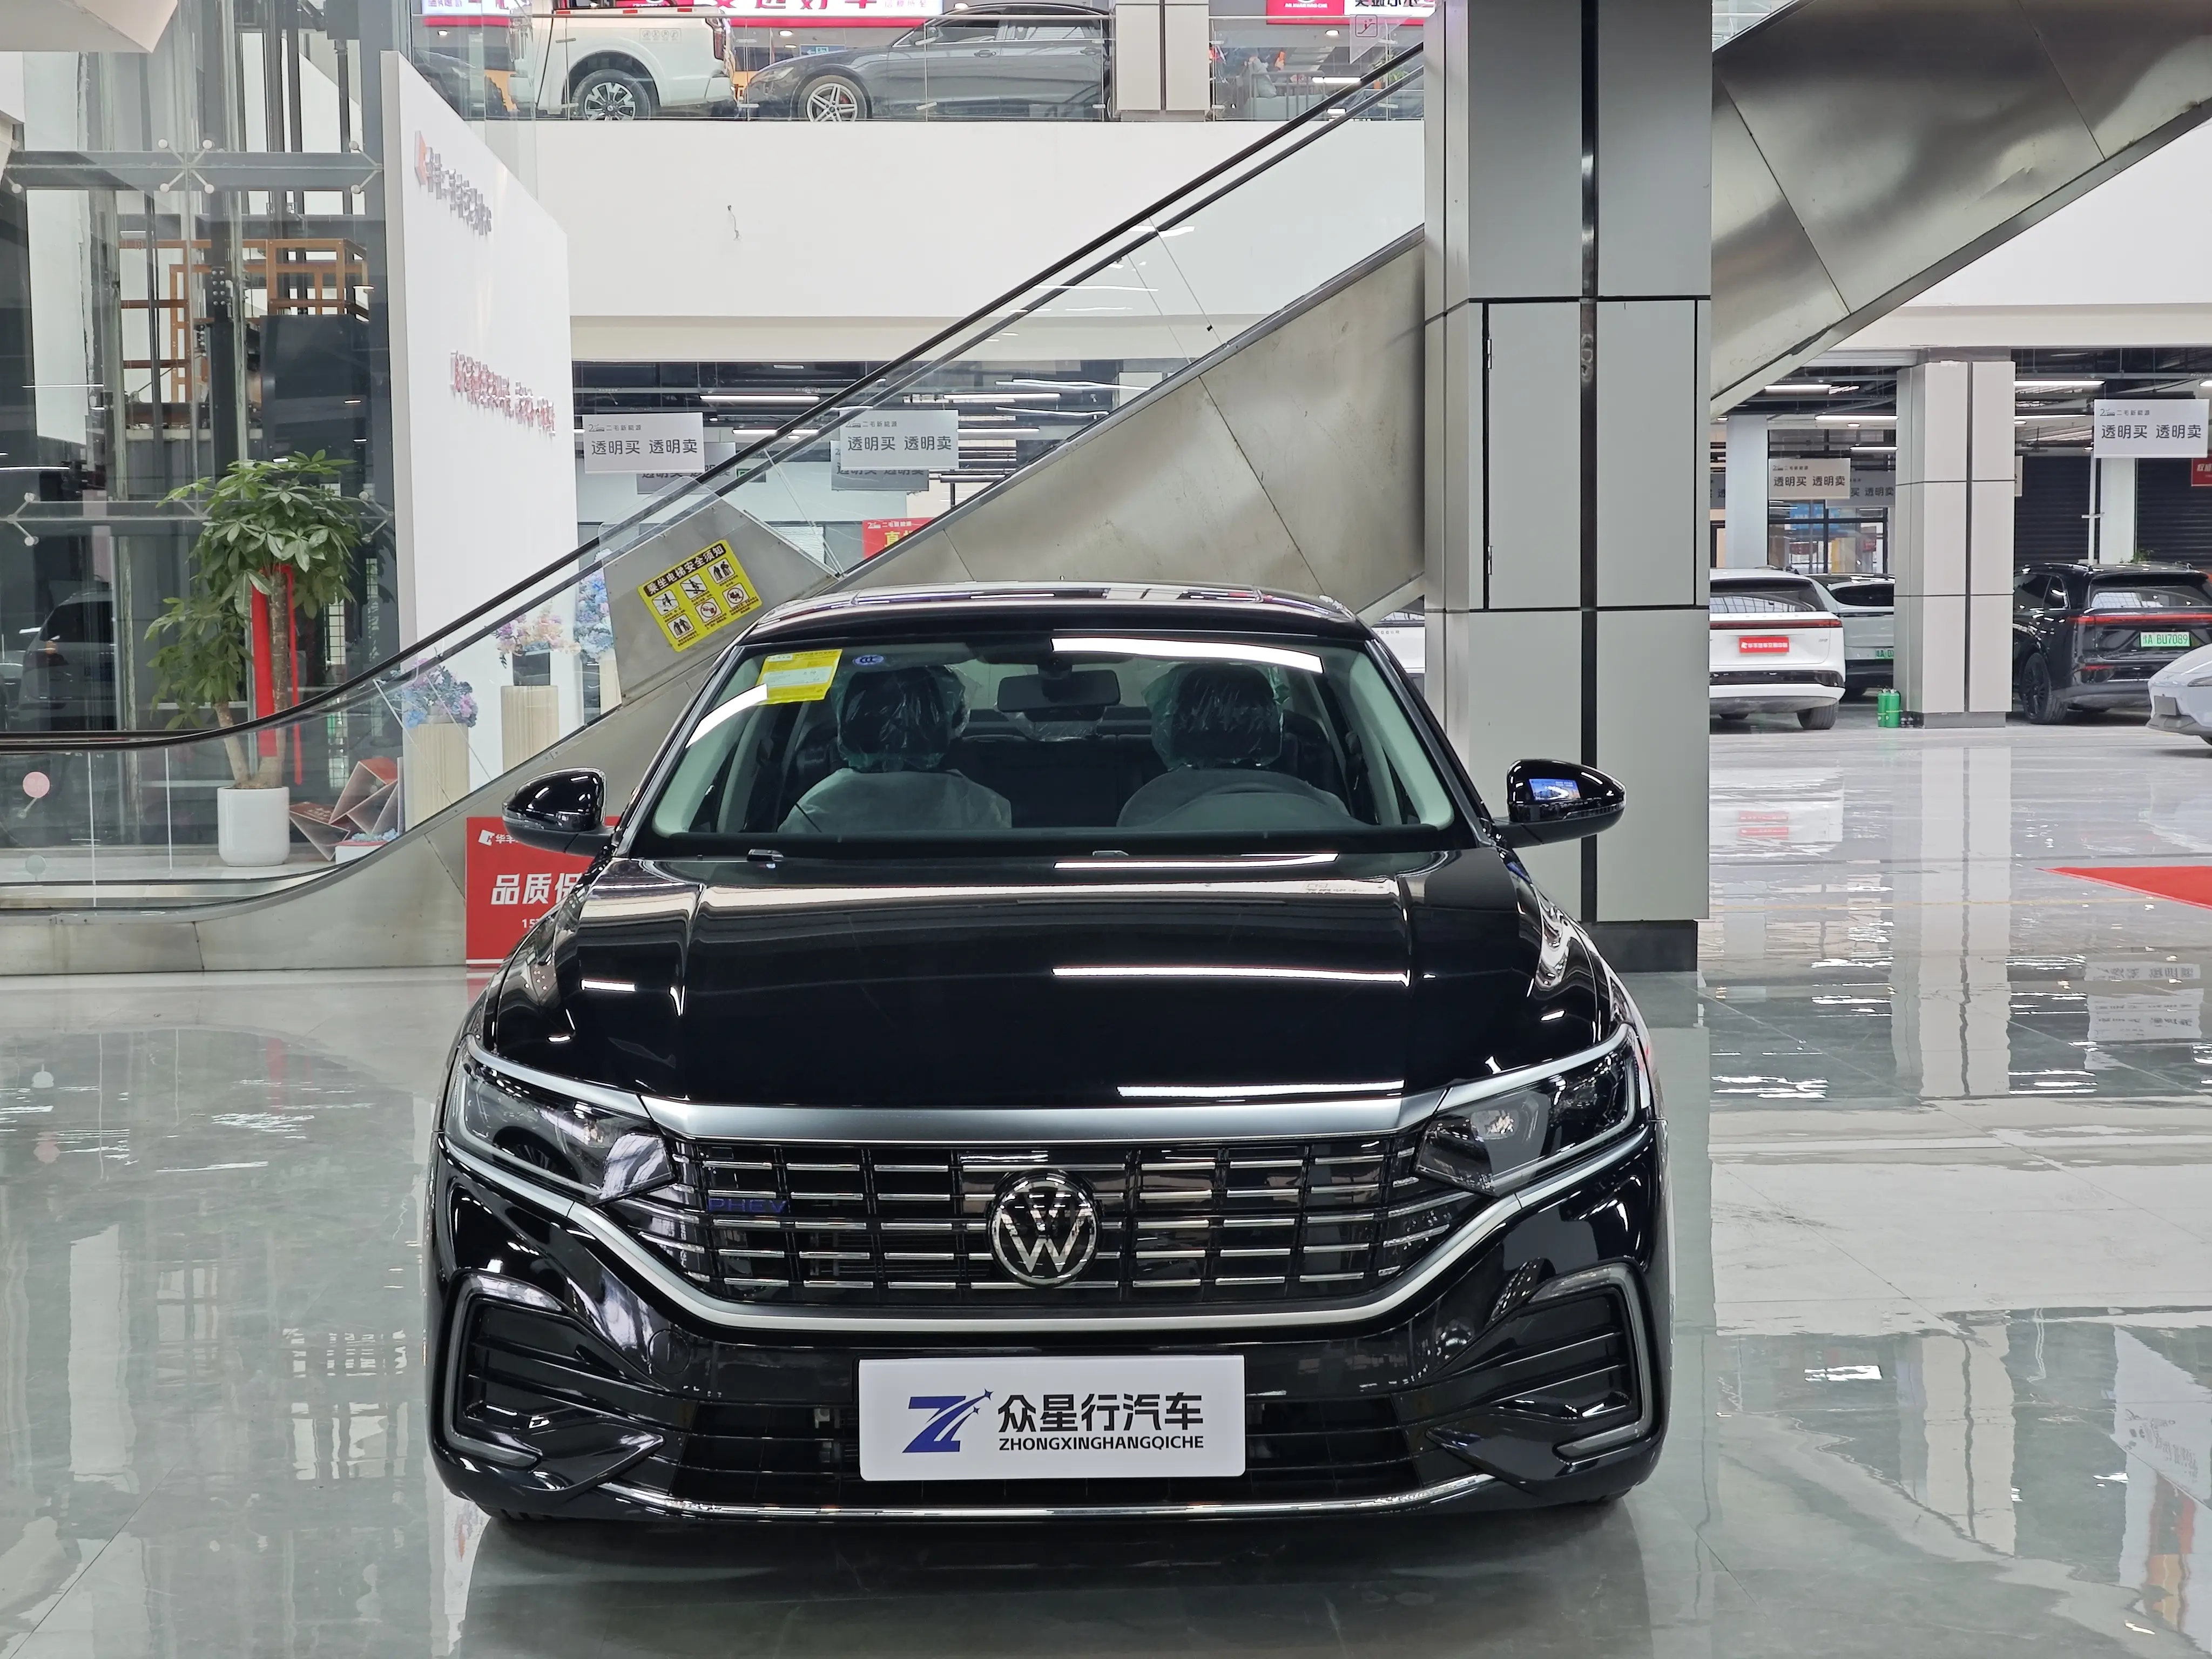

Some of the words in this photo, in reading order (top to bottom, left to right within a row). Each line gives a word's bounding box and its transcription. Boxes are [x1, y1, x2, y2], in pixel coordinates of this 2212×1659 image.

[2102, 425, 2148, 439] 透明买
[2156, 424, 2202, 439] 透明卖
[591, 440, 640, 455] 透明买
[649, 439, 698, 454] 透明卖
[848, 436, 895, 450] 透明买
[904, 436, 952, 450] 透明卖
[1773, 476, 1806, 487] 透明买
[1812, 476, 1845, 486] 透明卖
[647, 545, 724, 595] 乘坐电梯安全须知
[2156, 634, 2188, 644] BU7089
[708, 1198, 787, 1213] PHEV
[997, 1392, 1204, 1433] 众星行汽车
[999, 1435, 1204, 1451] ZHONGXINGHANGQICHE
